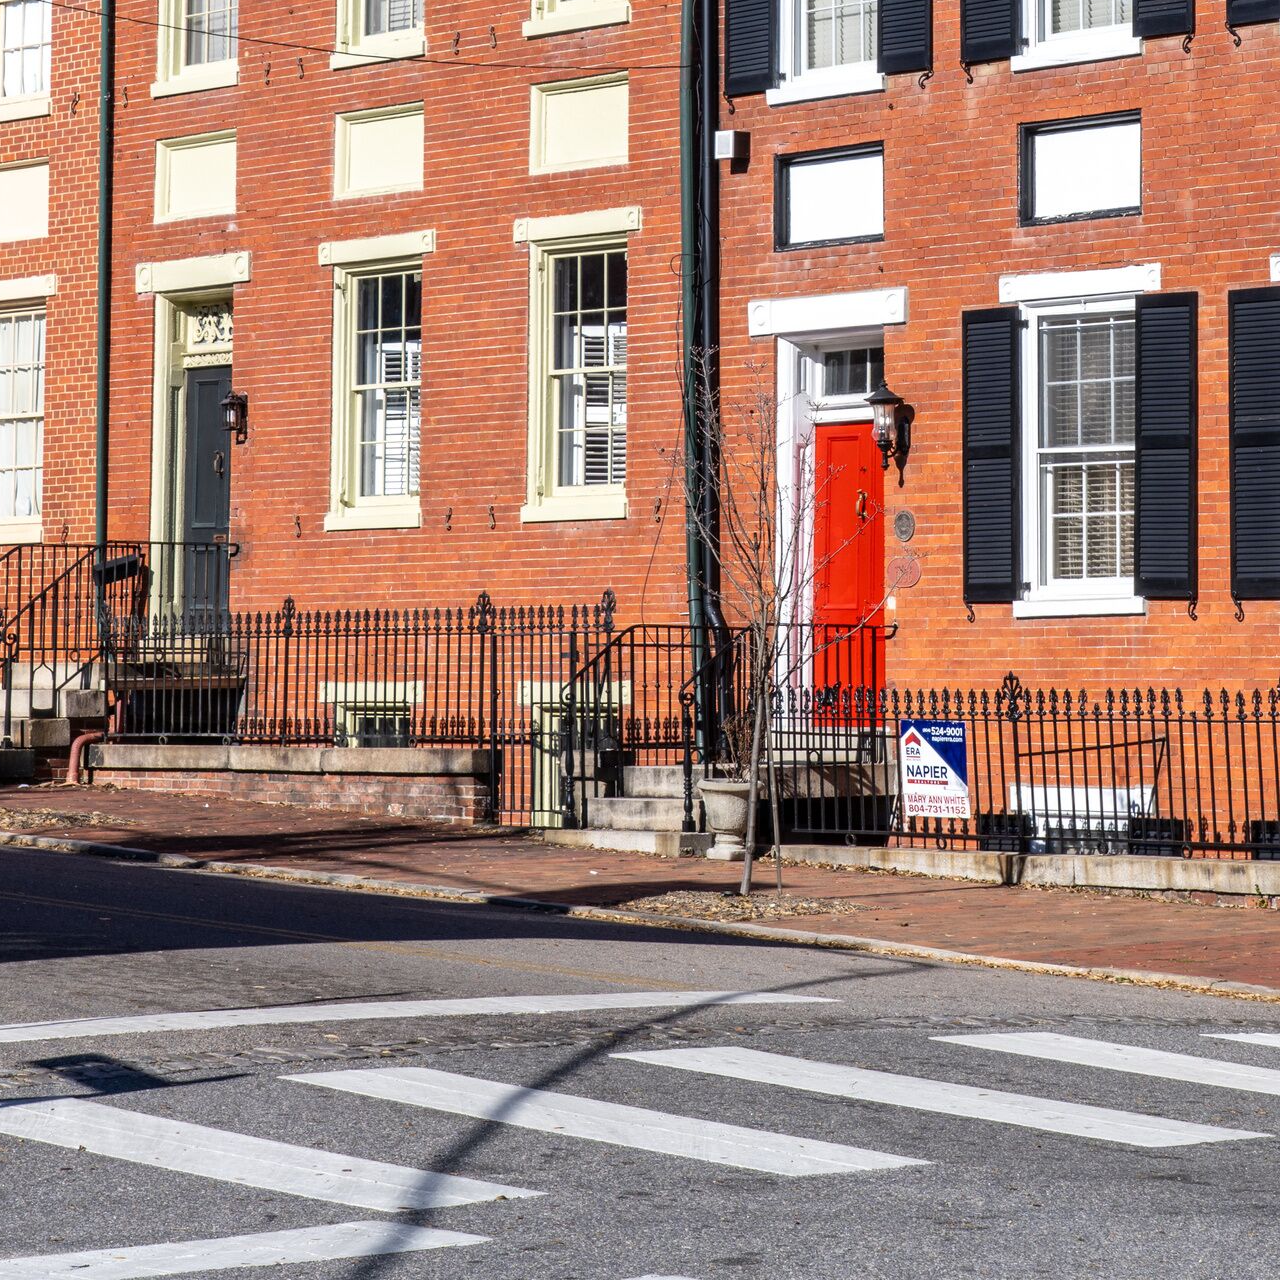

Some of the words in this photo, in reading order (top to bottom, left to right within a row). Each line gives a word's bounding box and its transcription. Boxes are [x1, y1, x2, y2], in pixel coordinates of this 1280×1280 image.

[931, 727, 963, 736] 524-9001
[906, 747, 921, 755] ERA
[906, 764, 948, 779] NAPIER
[908, 795, 926, 803] MARY
[928, 796, 942, 804] ANN
[943, 796, 966, 806] WHITE
[908, 805, 966, 814] 804-731-1152
